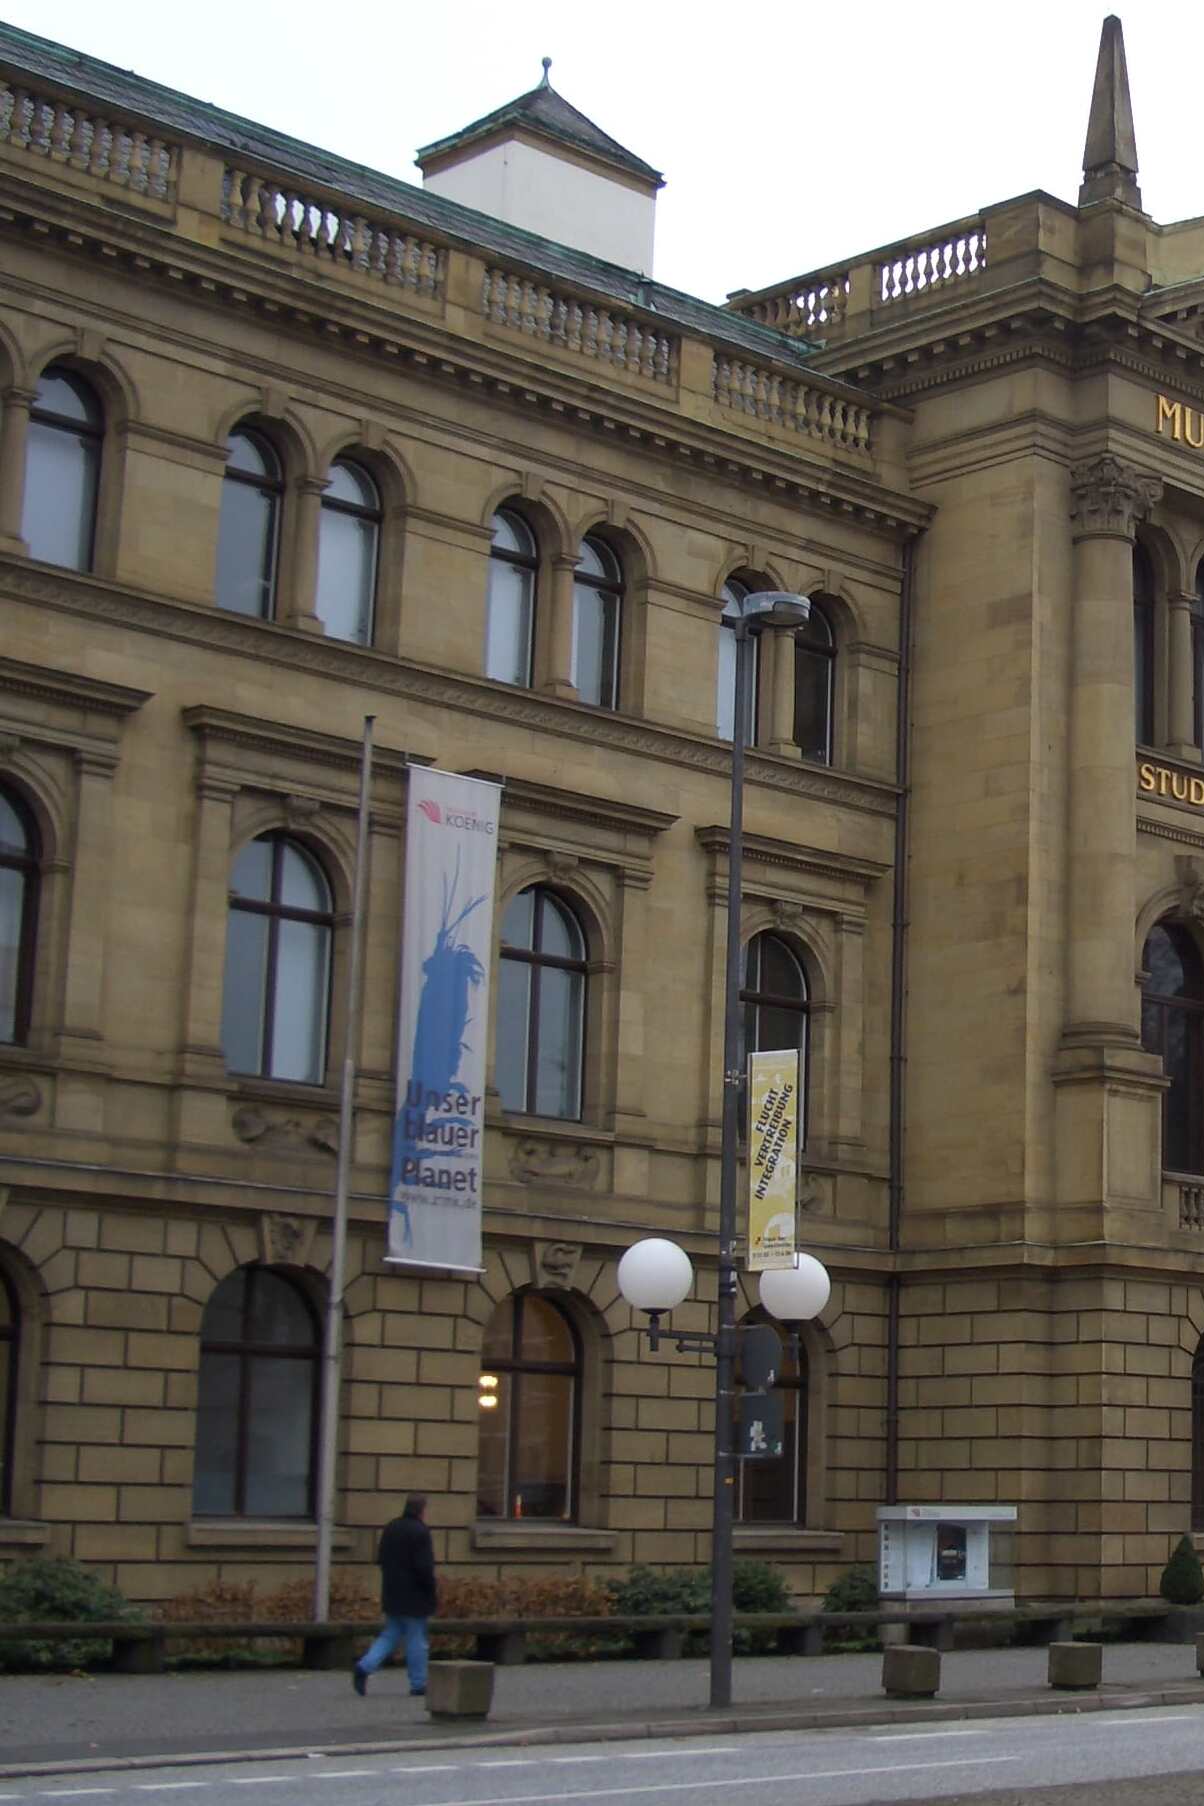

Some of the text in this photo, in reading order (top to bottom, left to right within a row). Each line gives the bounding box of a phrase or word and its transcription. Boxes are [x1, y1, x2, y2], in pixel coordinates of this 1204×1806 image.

[406, 1079, 482, 1116] Unser
[755, 1087, 780, 1133] FLUCHT
[754, 1082, 793, 1167] VERTREIBUNG
[400, 1156, 478, 1193] Planet
[754, 1118, 792, 1200] INTEGRATION
